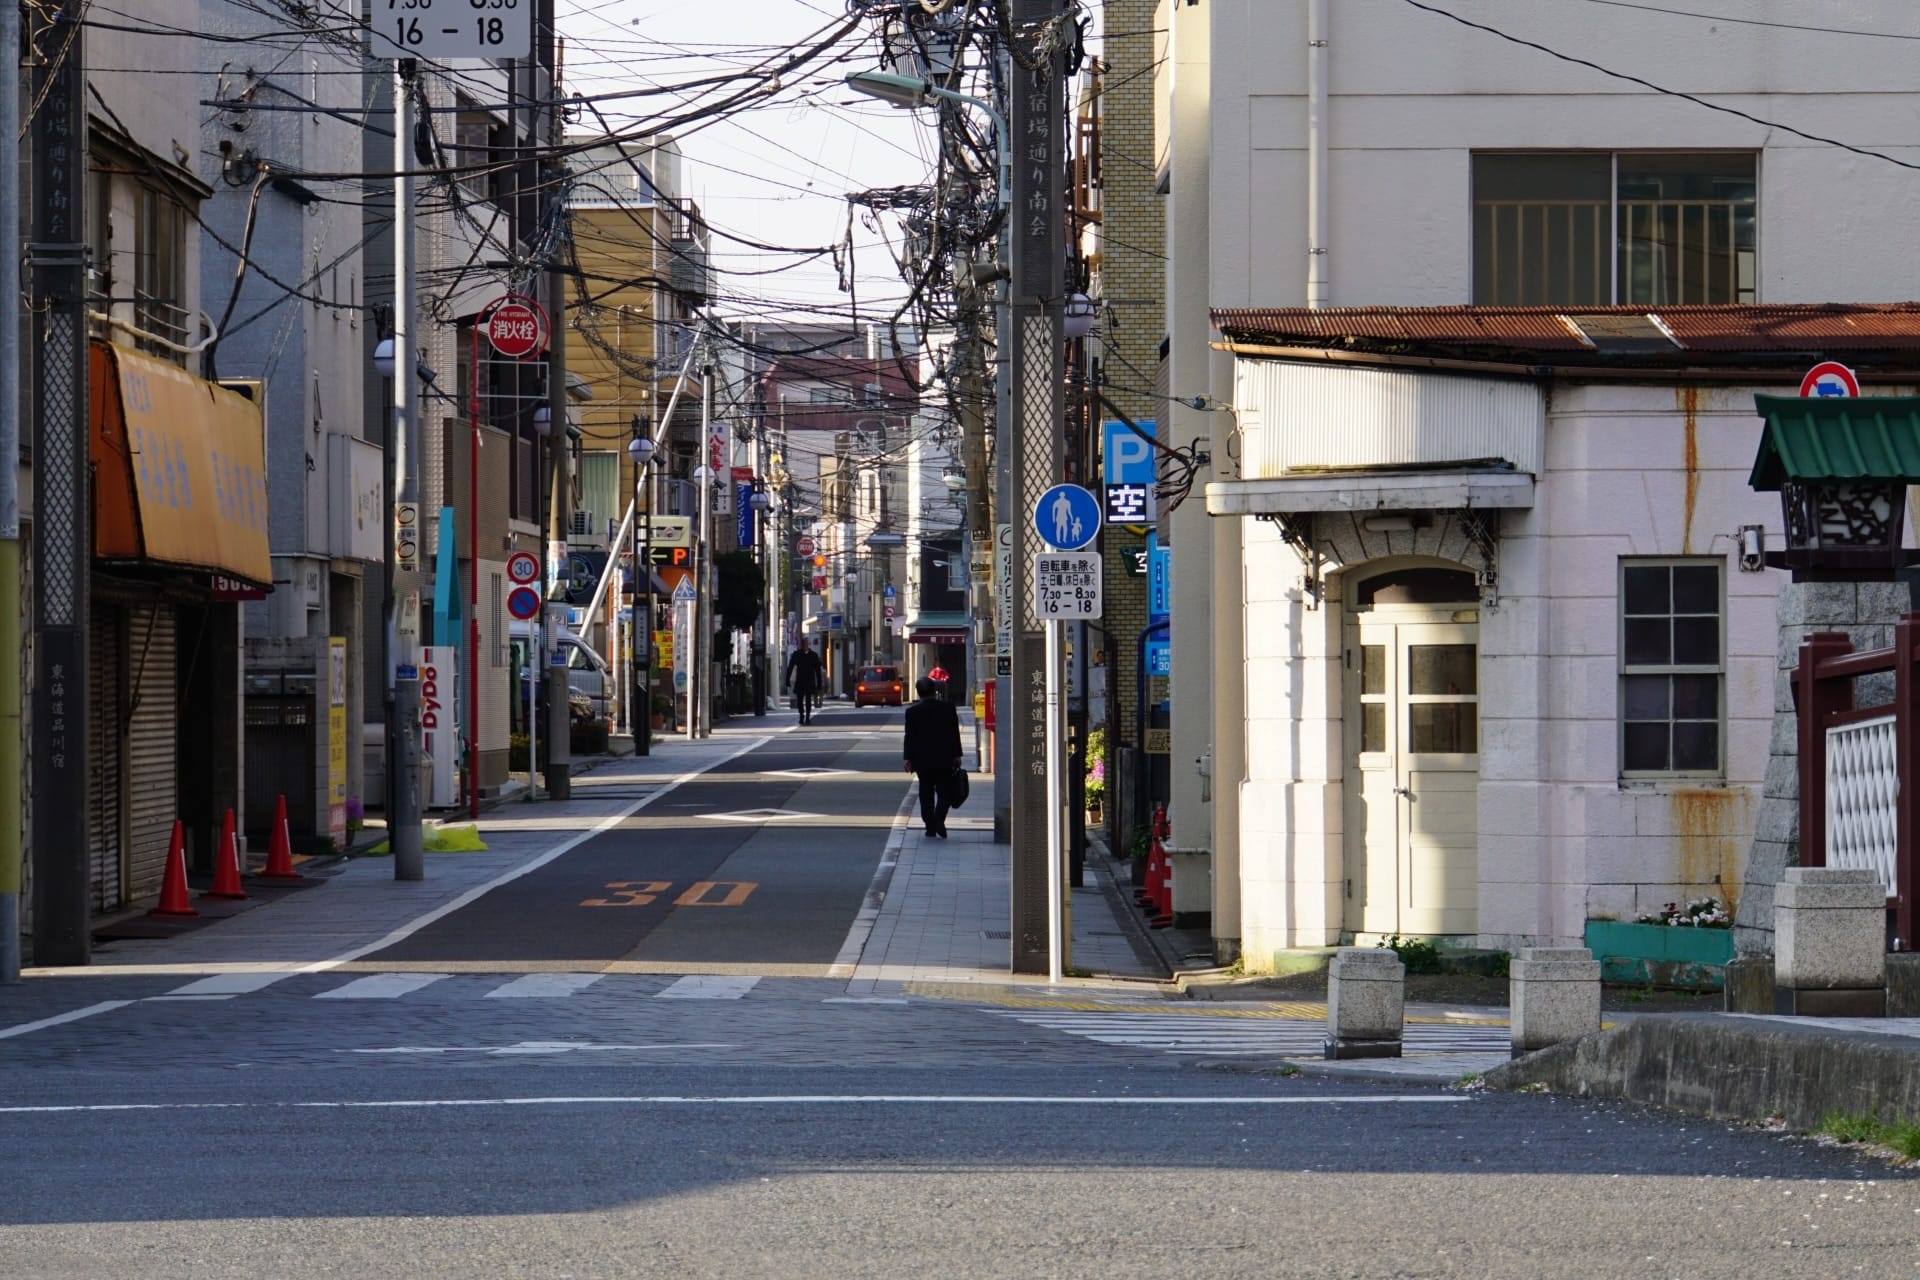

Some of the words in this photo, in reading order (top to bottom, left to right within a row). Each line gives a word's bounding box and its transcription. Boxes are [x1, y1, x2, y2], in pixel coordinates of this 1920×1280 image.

[397, 17, 424, 45] 16
[477, 17, 504, 45] 18
[493, 320, 535, 340] 消火栓
[1112, 434, 1149, 484] P
[1109, 485, 1145, 521] 空
[514, 561, 533, 576] 30
[674, 548, 687, 565] P
[1040, 560, 1096, 572] 自転車を除く
[1040, 587, 1061, 599] 7.30
[1075, 587, 1096, 599] 8.30
[1044, 600, 1059, 613] 16
[1078, 600, 1092, 613] 18
[423, 666, 441, 729] DyDo
[50, 663, 65, 769] 東海道品川宿
[1031, 669, 1046, 775] 東海道品川宿
[578, 881, 759, 907] 30
